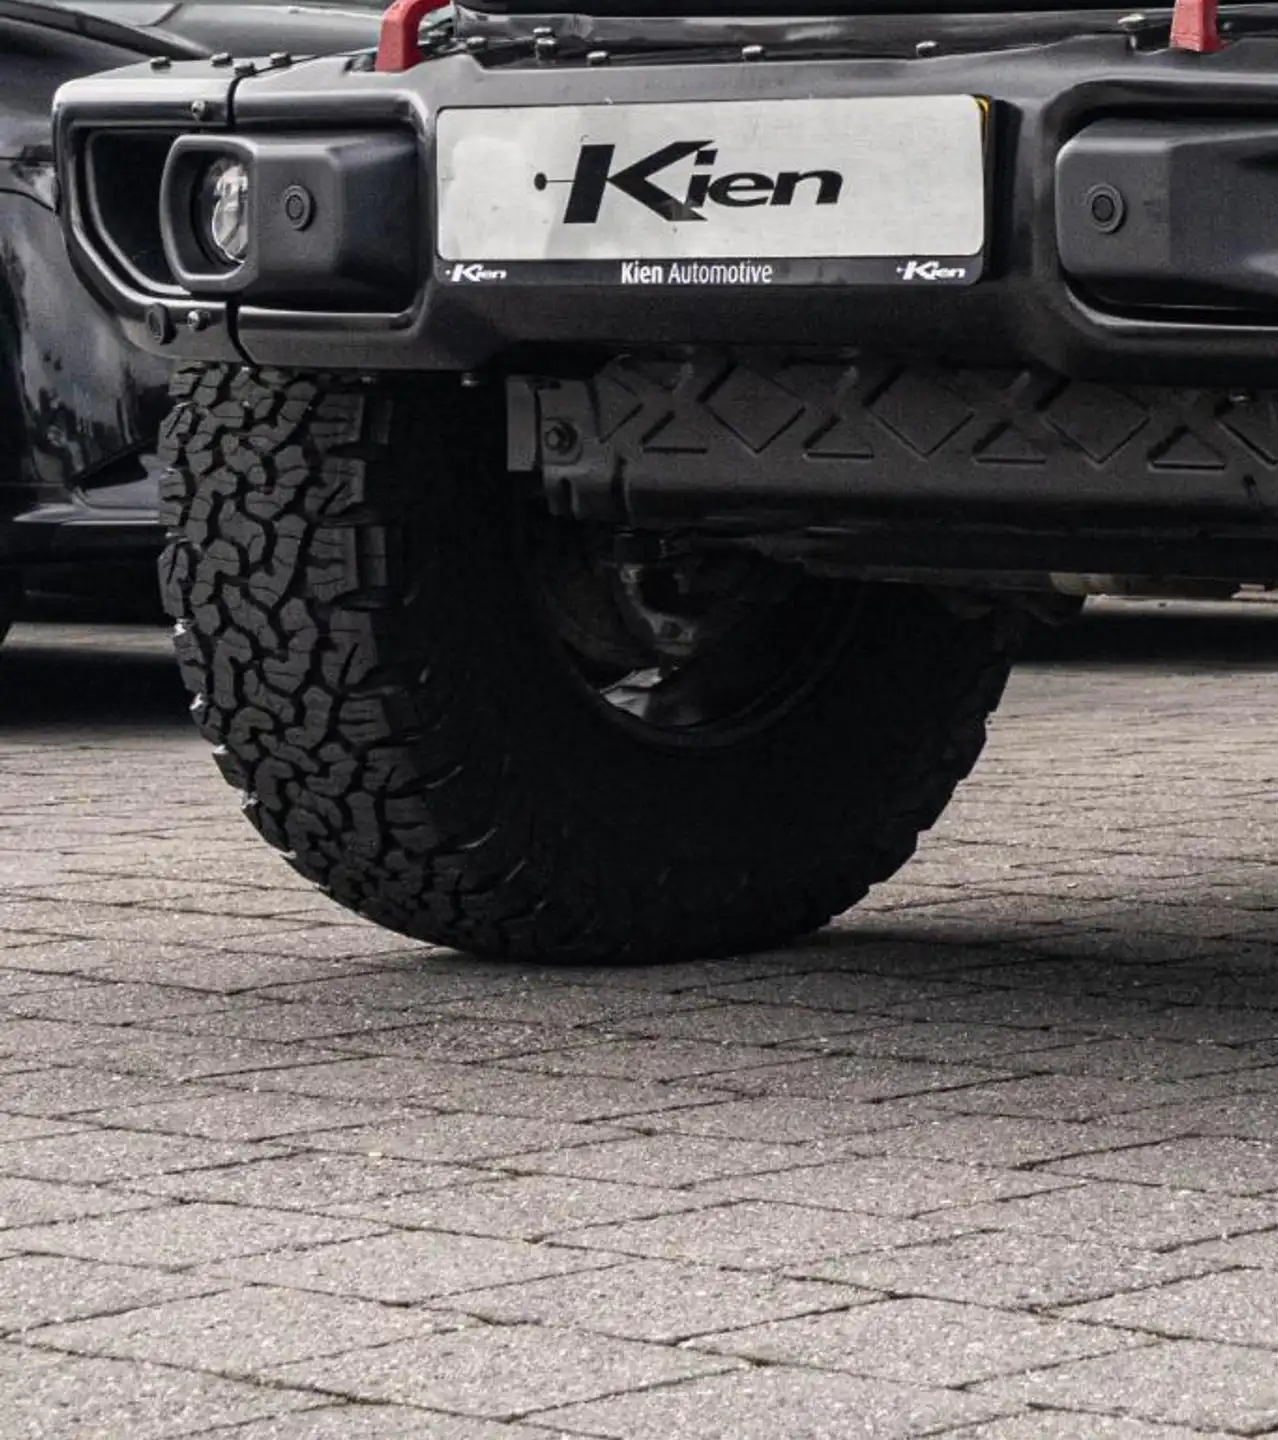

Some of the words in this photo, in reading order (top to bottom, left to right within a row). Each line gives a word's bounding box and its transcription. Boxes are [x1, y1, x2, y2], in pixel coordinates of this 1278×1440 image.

[563, 140, 843, 224] Kien
[620, 261, 664, 285] Kien
[668, 261, 774, 285] Automotive
